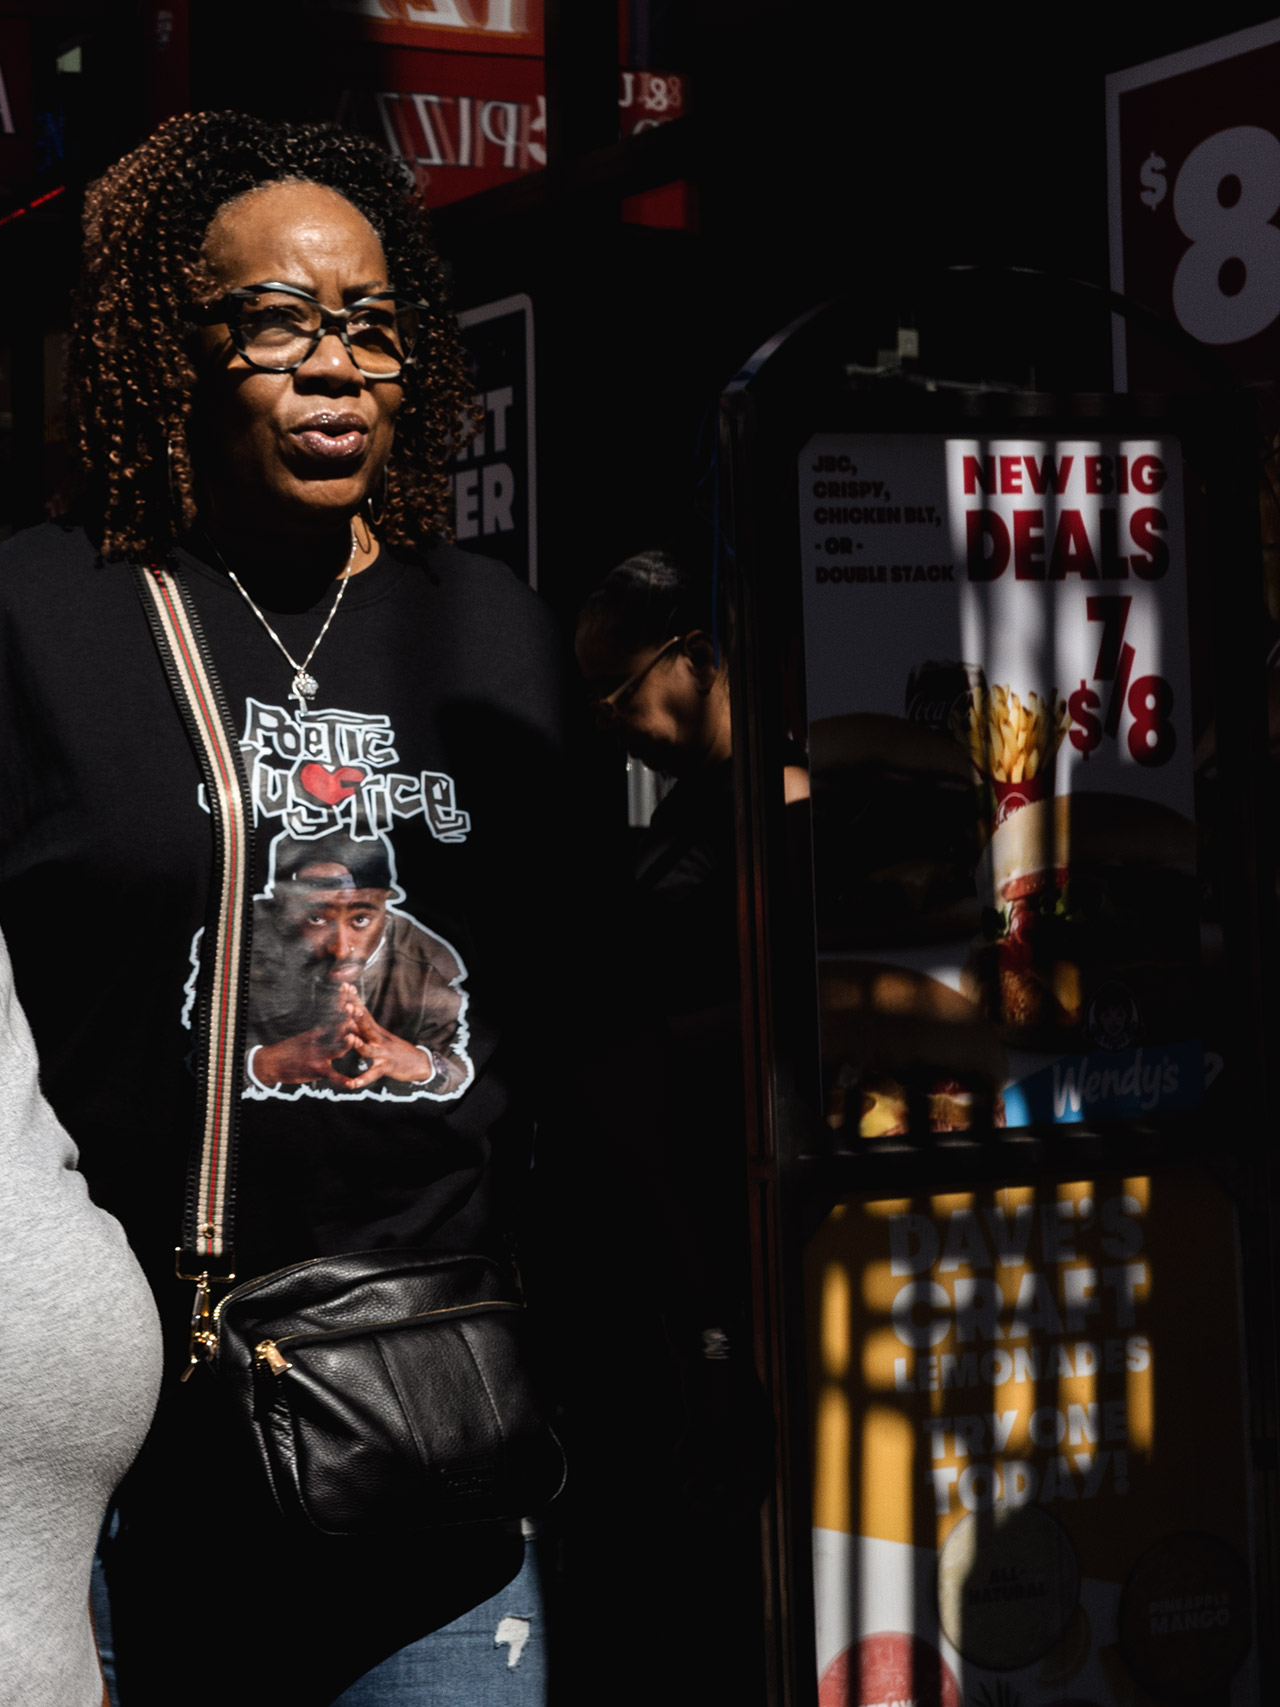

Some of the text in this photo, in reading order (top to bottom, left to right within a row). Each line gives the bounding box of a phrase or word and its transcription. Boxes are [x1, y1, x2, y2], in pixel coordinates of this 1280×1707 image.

[812, 455, 857, 476] JBC,
[813, 480, 891, 503] CRISPY,
[963, 455, 1167, 495] NEW BIG
[814, 506, 942, 527] CHICKEN BLT,
[966, 508, 1171, 582] DEALS
[815, 564, 955, 584] DOUBLE STACK
[1053, 1048, 1180, 1119] Wendy's
[888, 1195, 1144, 1278] DAVE'S
[891, 1262, 1147, 1349] CRAFT
[894, 1335, 1151, 1395] LEMONADES
[923, 1402, 1128, 1460] TRY ONE
[924, 1449, 1130, 1516] TODAY!
[1150, 1608, 1231, 1637] MANGO
